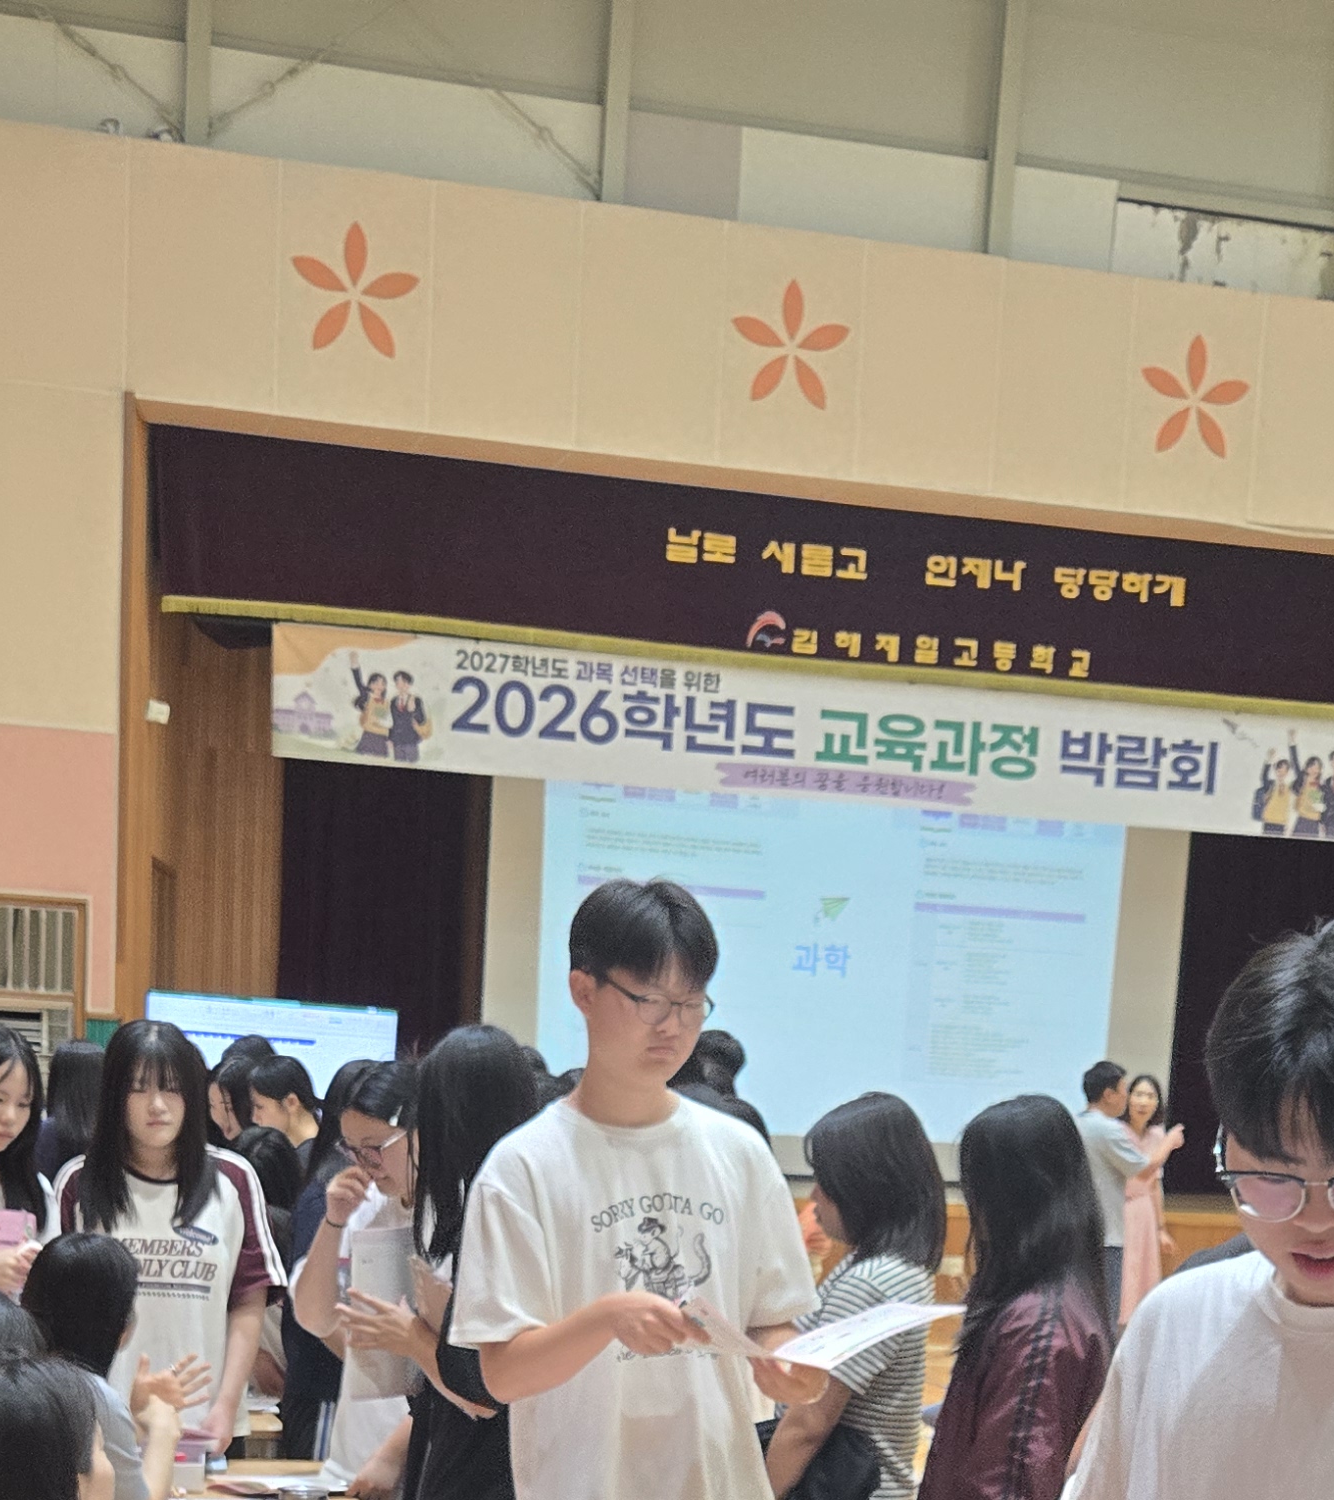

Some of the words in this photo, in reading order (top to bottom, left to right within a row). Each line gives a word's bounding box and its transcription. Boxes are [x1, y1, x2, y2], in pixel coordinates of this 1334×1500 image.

[665, 527, 738, 564] 날로
[761, 540, 869, 582] 새롭고
[924, 555, 1027, 592] 언제나
[1054, 566, 1188, 608] 당당하게
[455, 648, 569, 681] 2027학년도
[576, 657, 613, 685] 과목
[619, 662, 676, 690] 선택을
[683, 670, 721, 693] 위한
[450, 676, 797, 761] 2026학년도
[814, 707, 1040, 782] 교육과정
[1058, 728, 1222, 796] 박람회
[742, 767, 808, 790] 여러분의
[856, 778, 947, 801] 응원합니다!
[791, 943, 852, 979] 과학
[590, 1197, 637, 1234] SORRY
[638, 1191, 693, 1218] GOTTA
[699, 1201, 726, 1226] GO
[170, 1259, 218, 1282] CLUB
